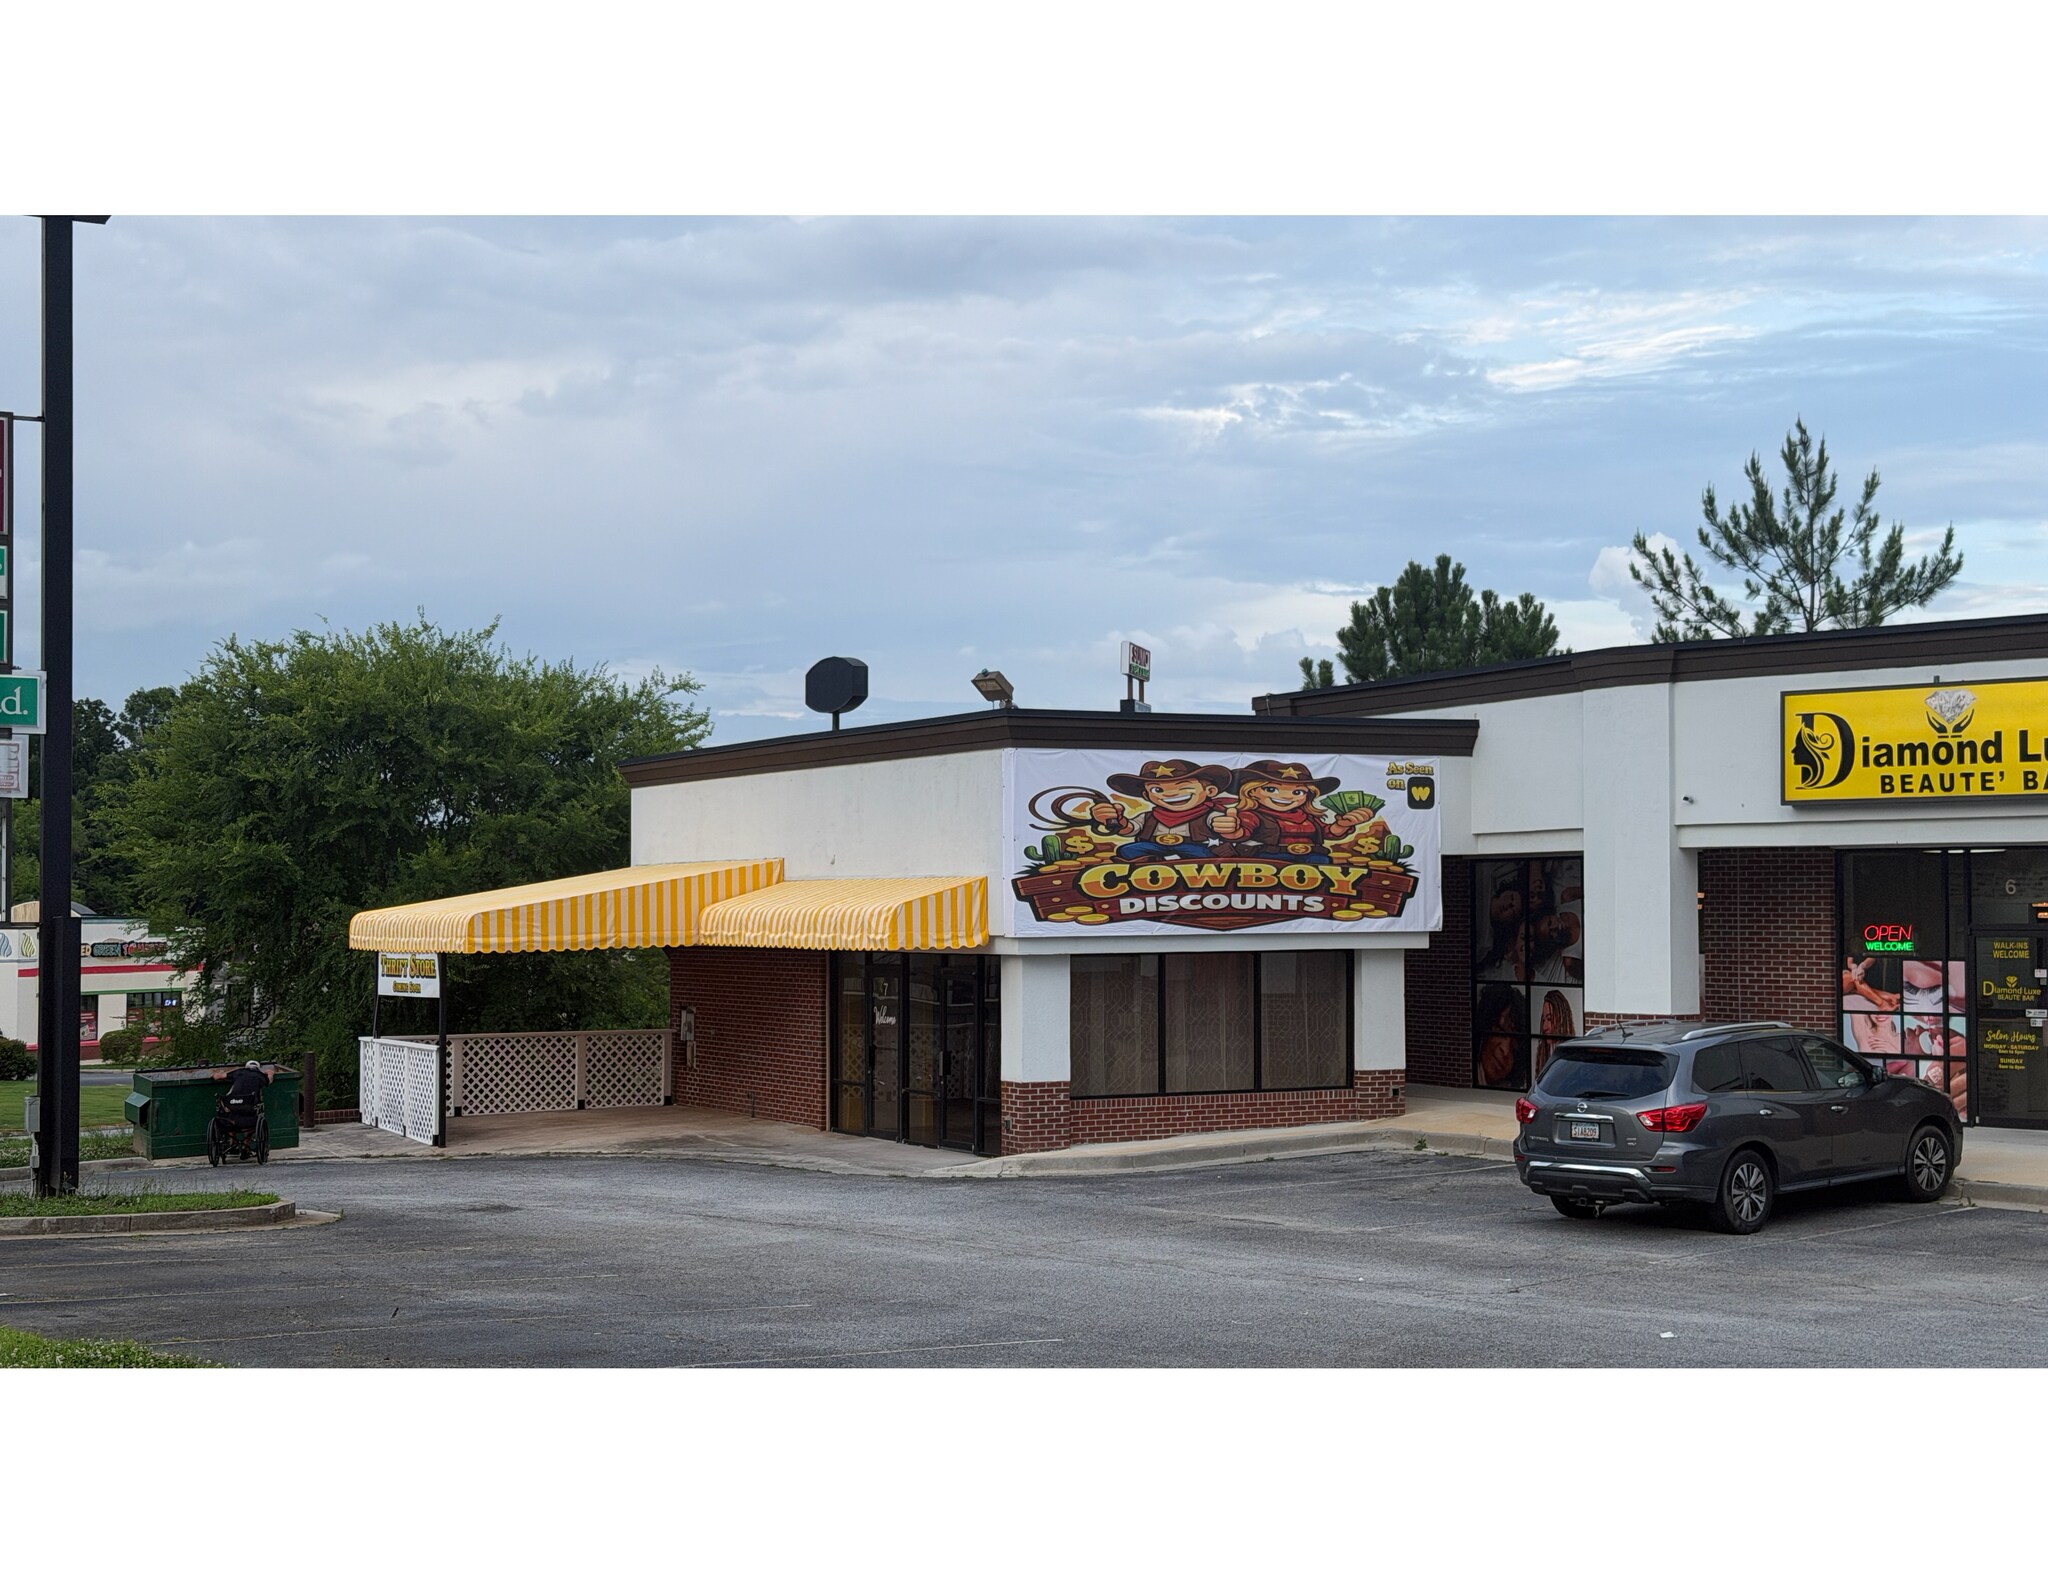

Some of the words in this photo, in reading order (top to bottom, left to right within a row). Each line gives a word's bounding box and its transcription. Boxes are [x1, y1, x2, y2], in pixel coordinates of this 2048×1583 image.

[0, 686, 29, 715] d.
[1791, 712, 2003, 789] Diamond
[2019, 730, 2048, 762] L
[1386, 762, 1404, 776] As
[1405, 762, 1434, 776] Seen
[1387, 779, 1406, 791] on
[1079, 863, 1368, 898] COWBOY
[2005, 879, 2016, 895] 6
[1119, 894, 1325, 914] DISCOUNTS
[1864, 925, 1912, 941] OPEN
[1865, 941, 1914, 951] WELCOME
[1993, 941, 2029, 950] WALK-INS
[1993, 950, 2030, 959] WELCOME
[409, 954, 437, 978] STORE
[883, 982, 888, 996] 7
[1983, 980, 2022, 996] Diamond
[2023, 987, 2041, 996] Luxe
[873, 1005, 896, 1025] Welcome
[1986, 1030, 2009, 1042] Salon
[2010, 1031, 2036, 1044] Hours
